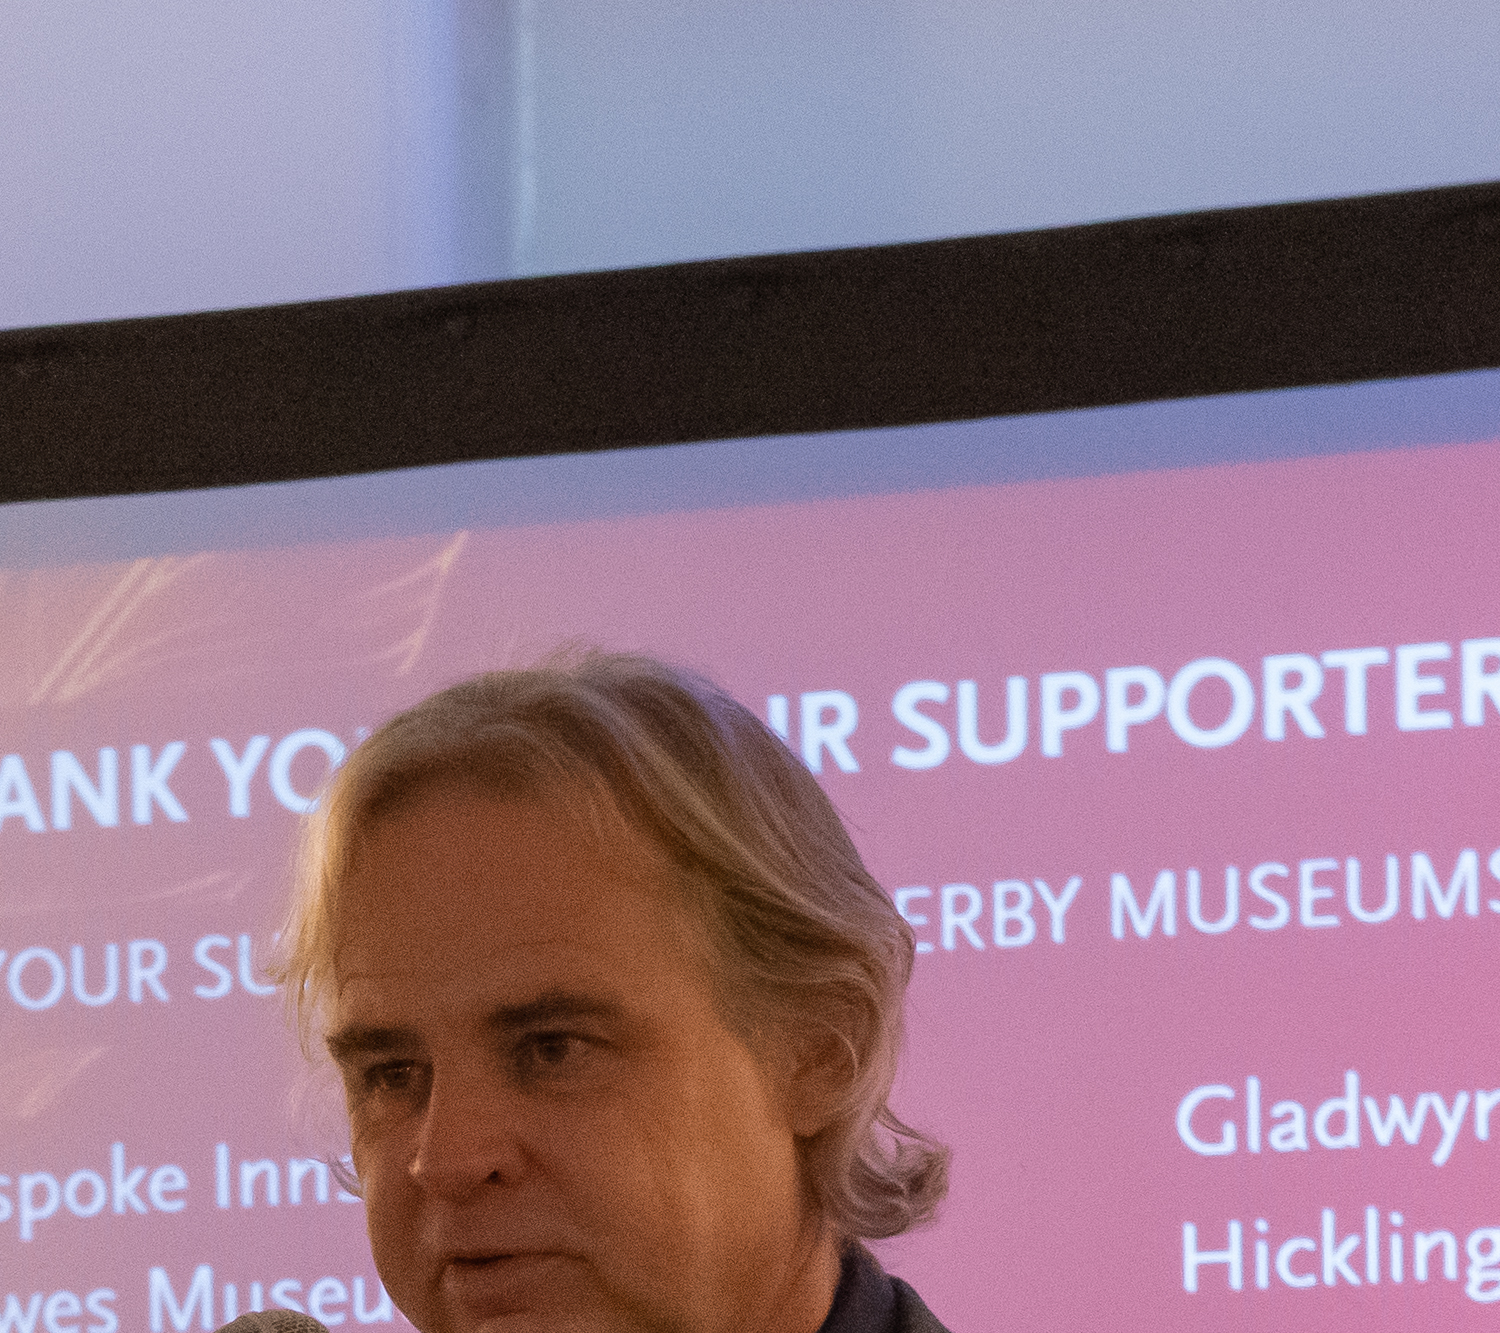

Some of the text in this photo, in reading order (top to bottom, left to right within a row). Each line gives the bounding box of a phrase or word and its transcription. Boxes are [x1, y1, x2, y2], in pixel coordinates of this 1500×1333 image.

[210, 727, 370, 818] YO
[193, 933, 282, 999] SU
[894, 876, 1083, 954] ERBY
[148, 1263, 395, 1333] Museu
